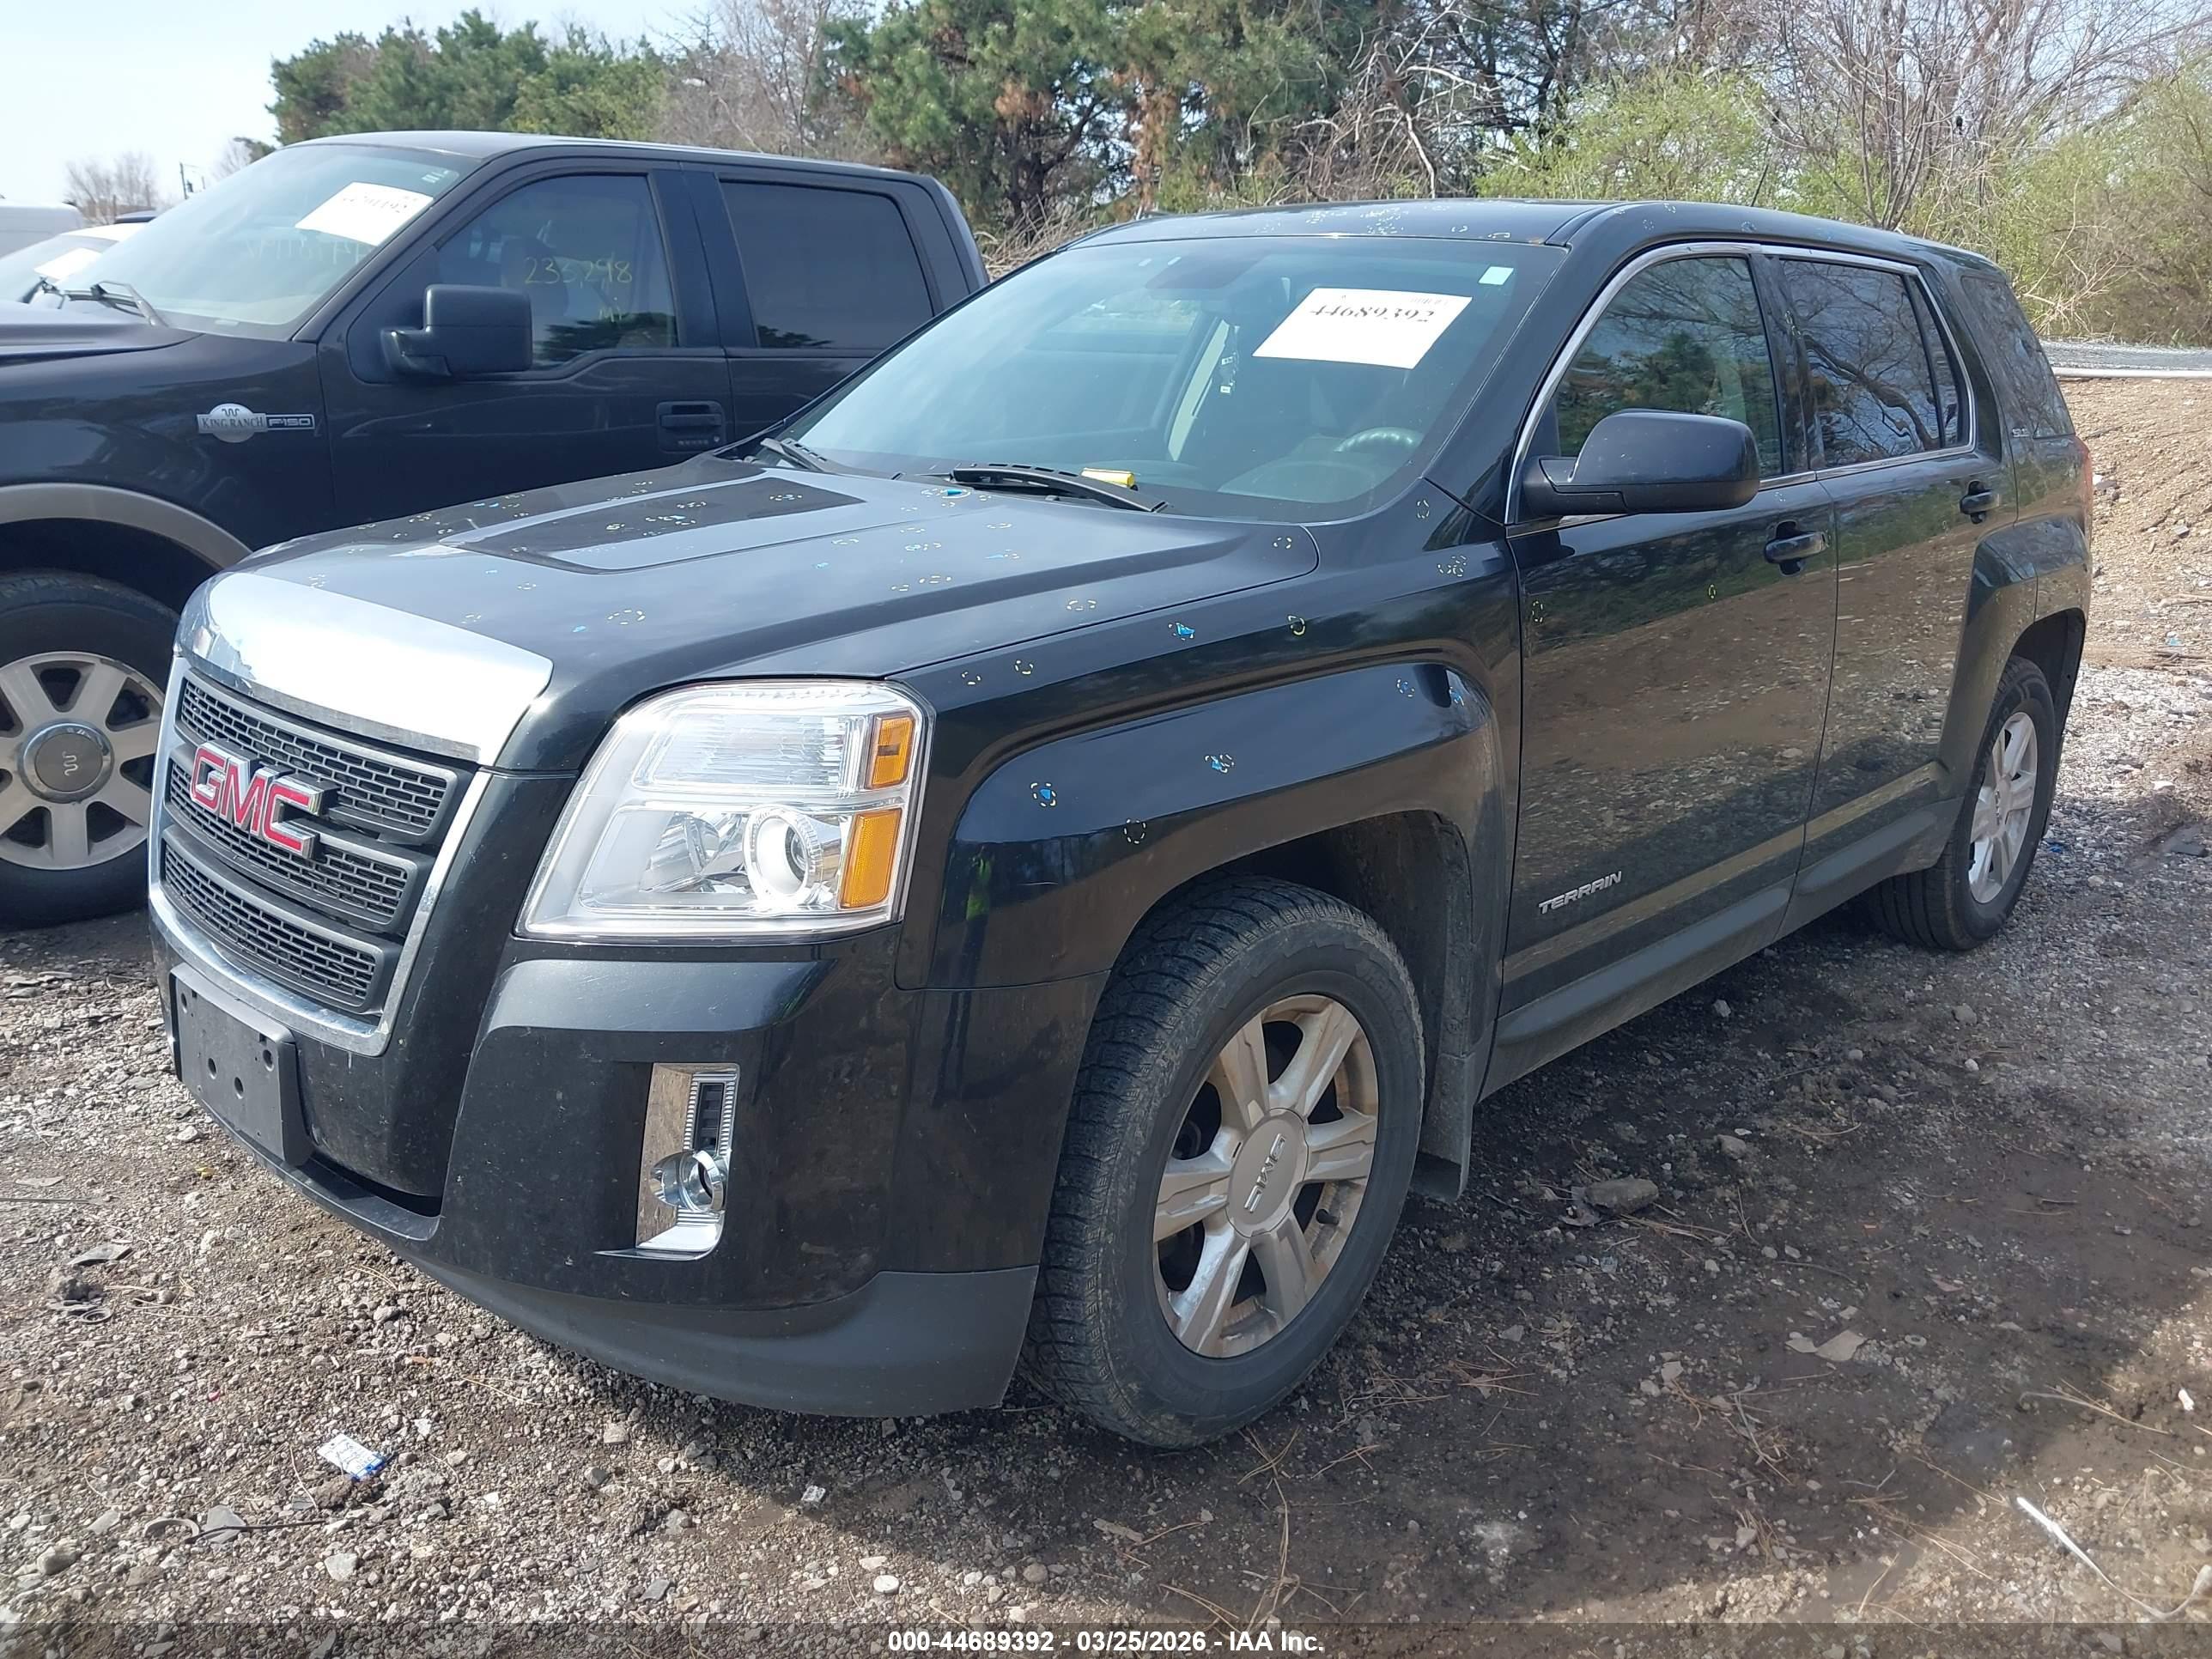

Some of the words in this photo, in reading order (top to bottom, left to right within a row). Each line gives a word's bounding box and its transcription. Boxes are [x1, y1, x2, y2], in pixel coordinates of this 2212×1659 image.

[1310, 304, 1435, 323] 44689392
[201, 417, 228, 428] KING
[229, 416, 264, 428] RANCH
[190, 742, 324, 859] GMC
[1539, 871, 1622, 915] TERRAIN
[1243, 1133, 1286, 1214] GMC
